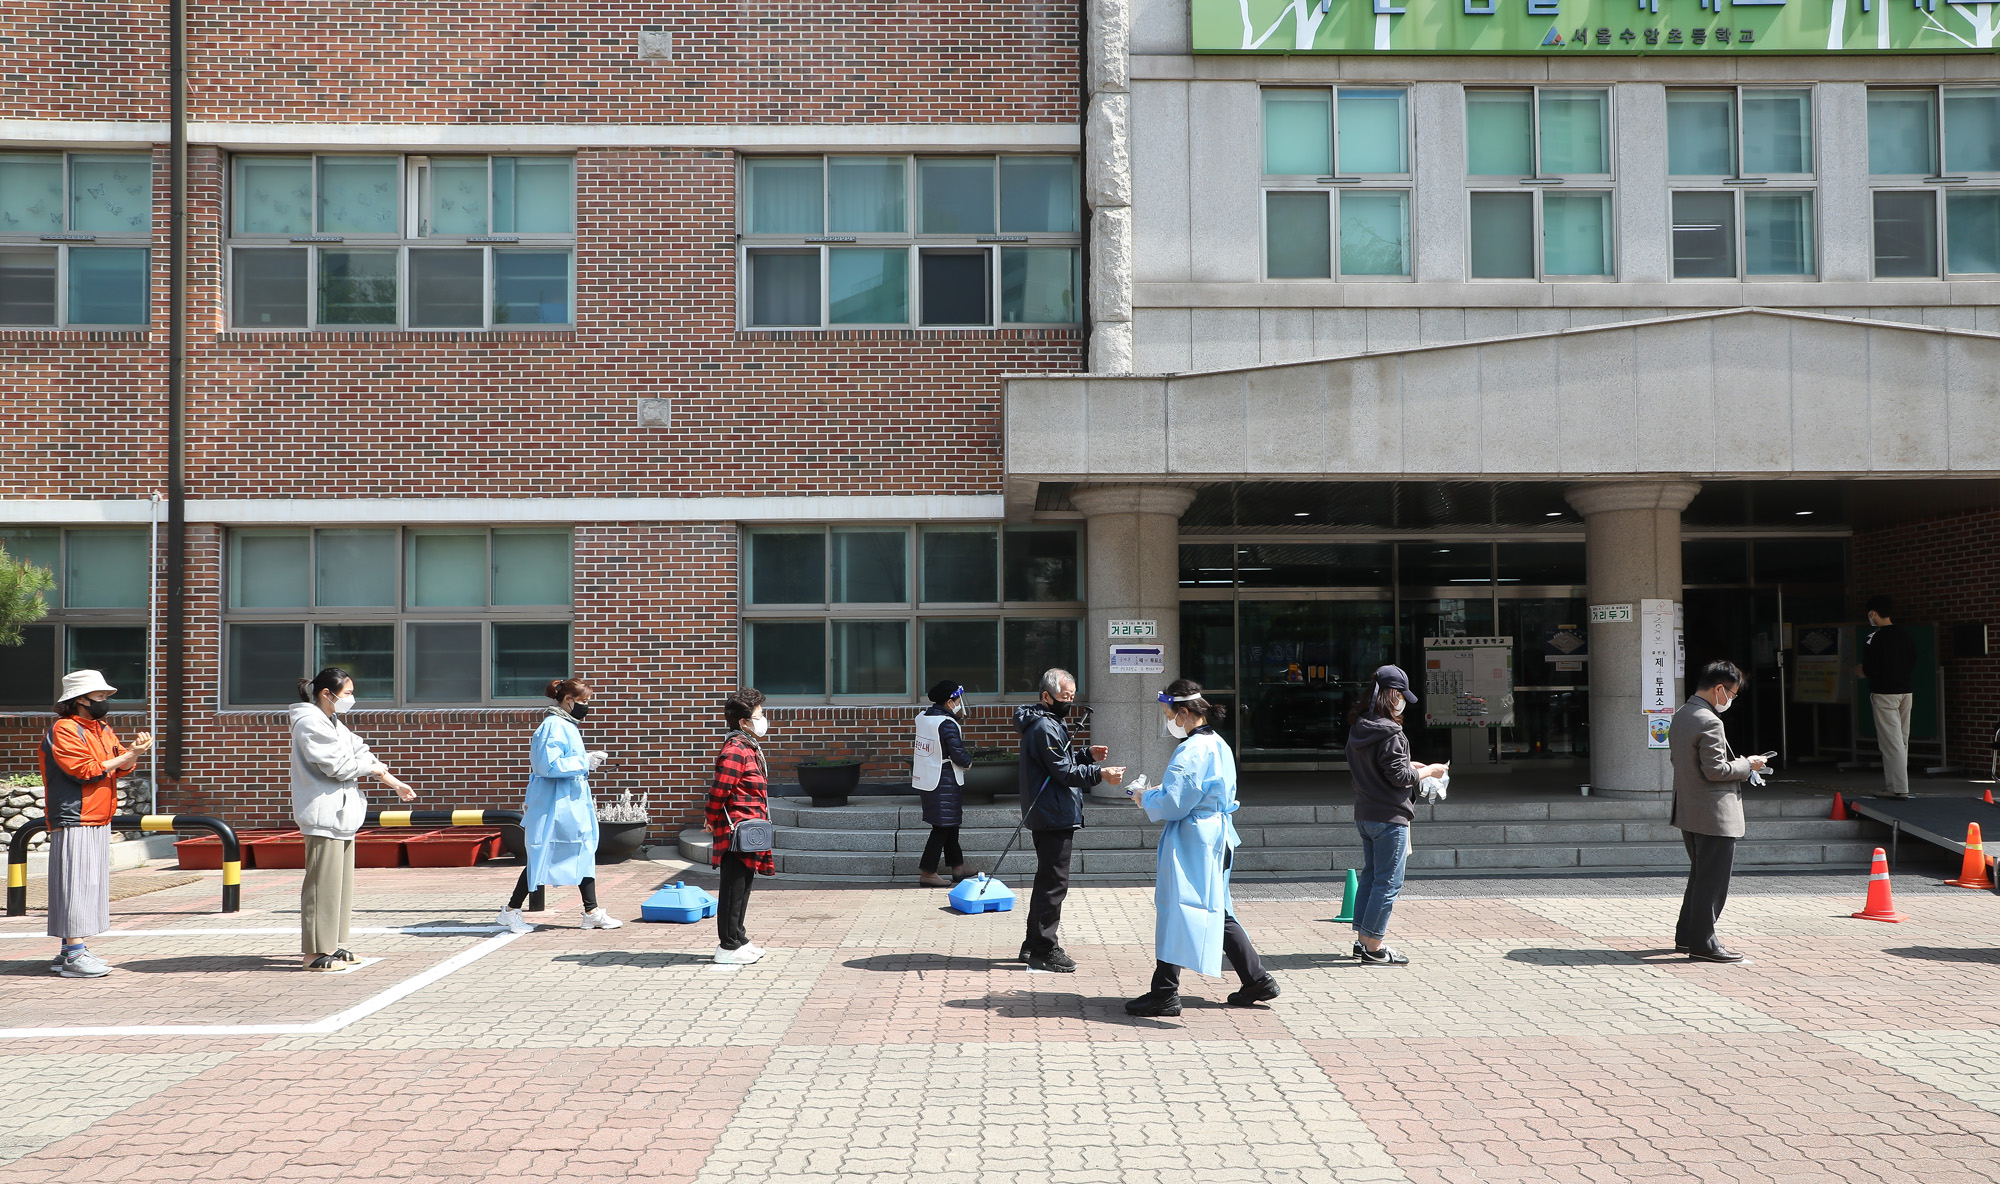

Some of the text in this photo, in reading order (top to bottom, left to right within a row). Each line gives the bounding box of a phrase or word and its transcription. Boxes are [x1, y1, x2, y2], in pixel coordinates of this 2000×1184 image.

[1572, 28, 1755, 45] 서울수암초등학교
[1593, 610, 1629, 620] 거리두기
[1111, 626, 1154, 635] 거리두기
